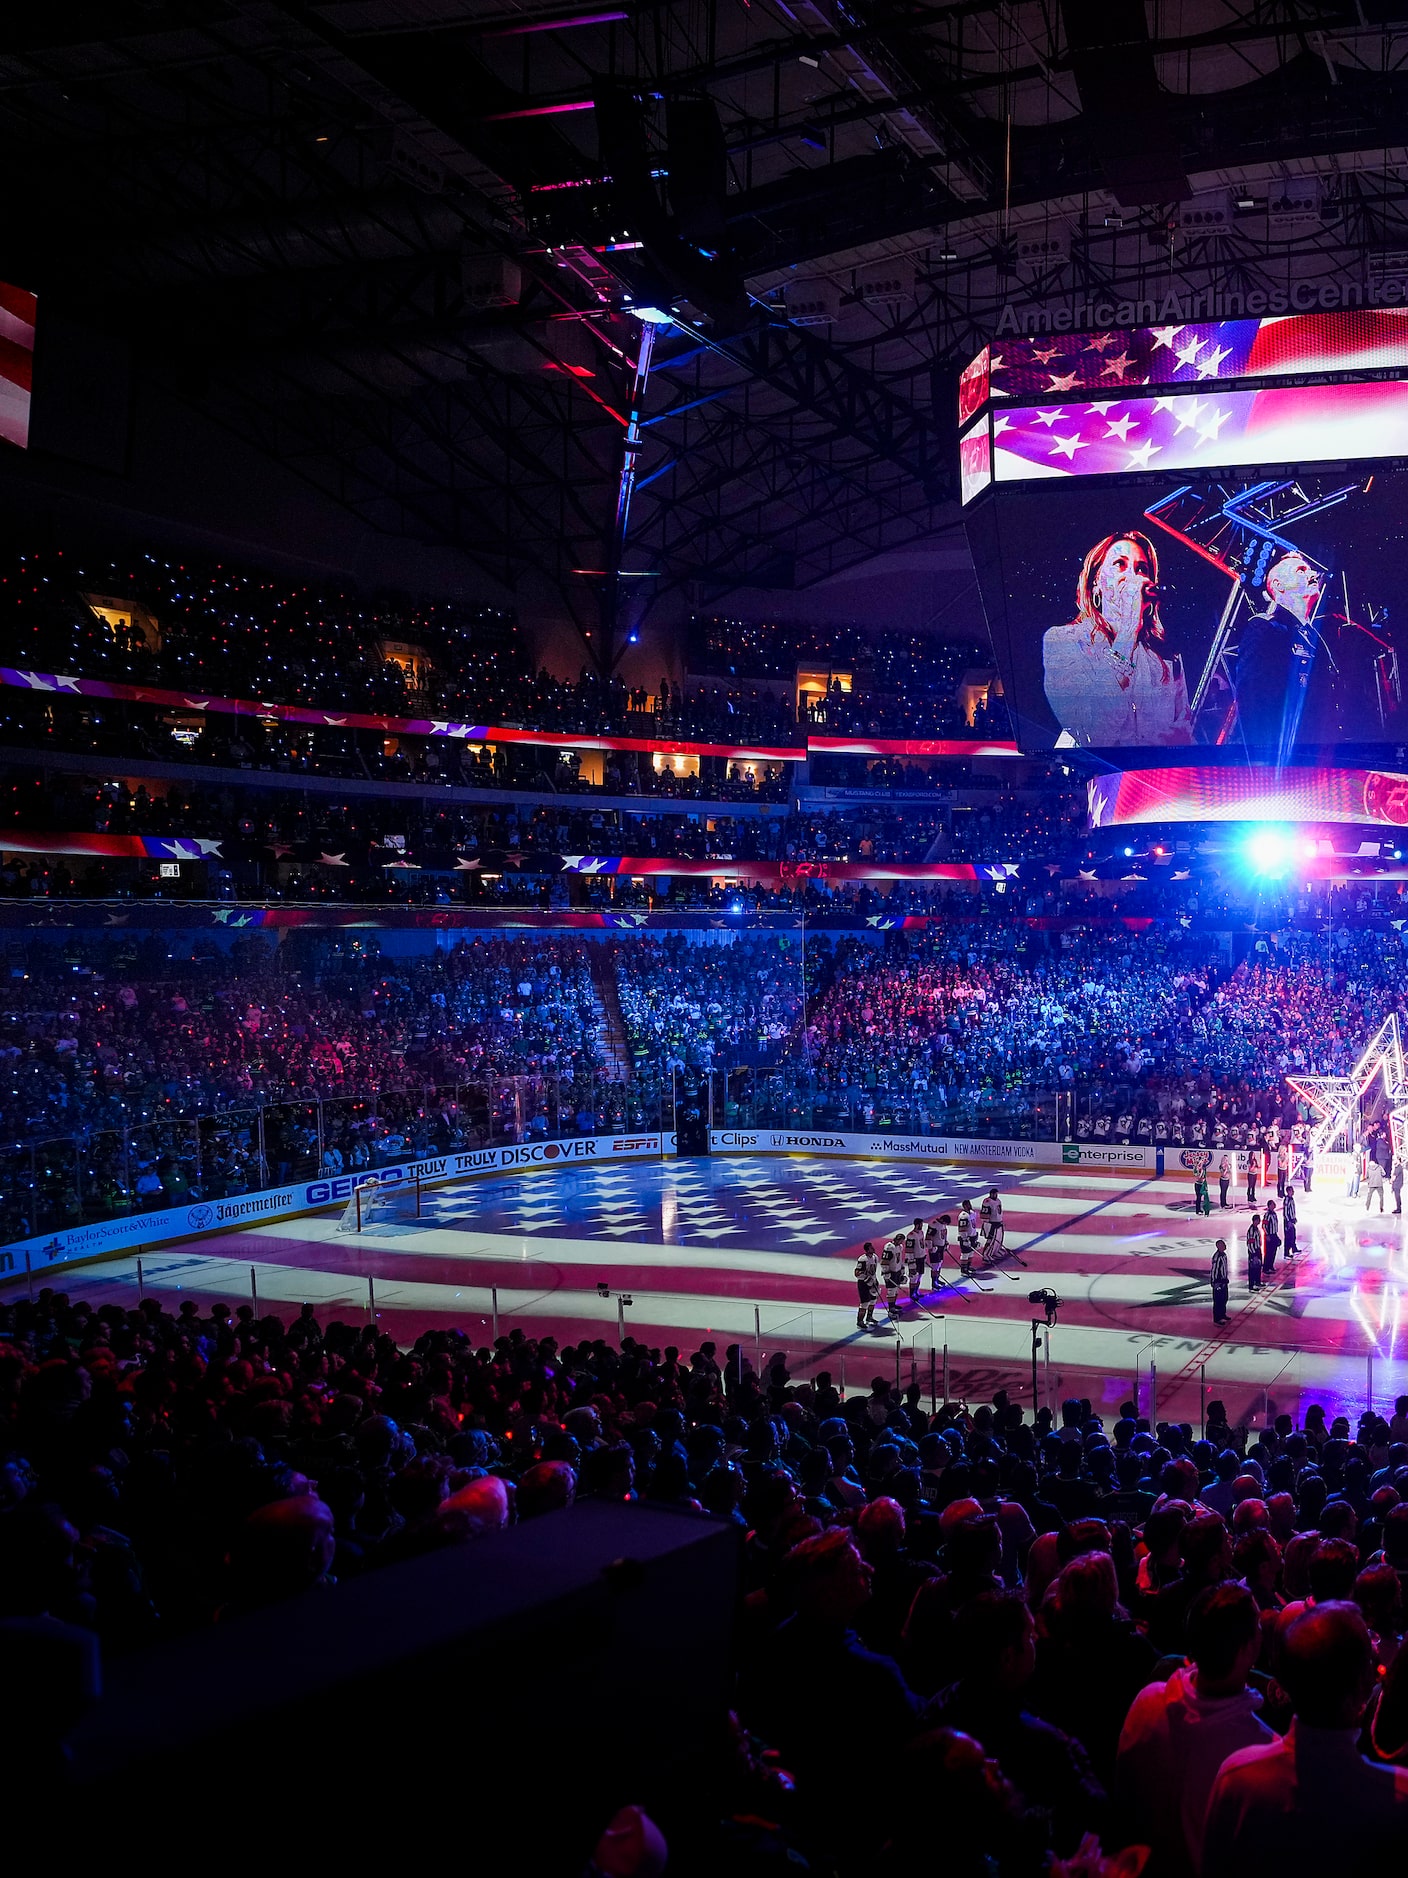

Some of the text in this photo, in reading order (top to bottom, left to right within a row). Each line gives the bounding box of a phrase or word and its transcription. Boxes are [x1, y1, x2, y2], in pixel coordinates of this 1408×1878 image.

[613, 1138, 658, 1151] ESPN
[721, 1132, 757, 1148] Clips
[786, 1136, 846, 1148] HONDA
[883, 1140, 948, 1154] MassMutual
[501, 1140, 597, 1165] DISCOVER
[954, 1143, 968, 1154] NEW
[970, 1144, 1012, 1156] AMSTERDAM
[1066, 1147, 1144, 1163] enterprise
[407, 1159, 447, 1178] TRULY
[455, 1151, 497, 1170] TRULY
[306, 1168, 402, 1204] GEICO
[216, 1191, 294, 1221] Jägermeister
